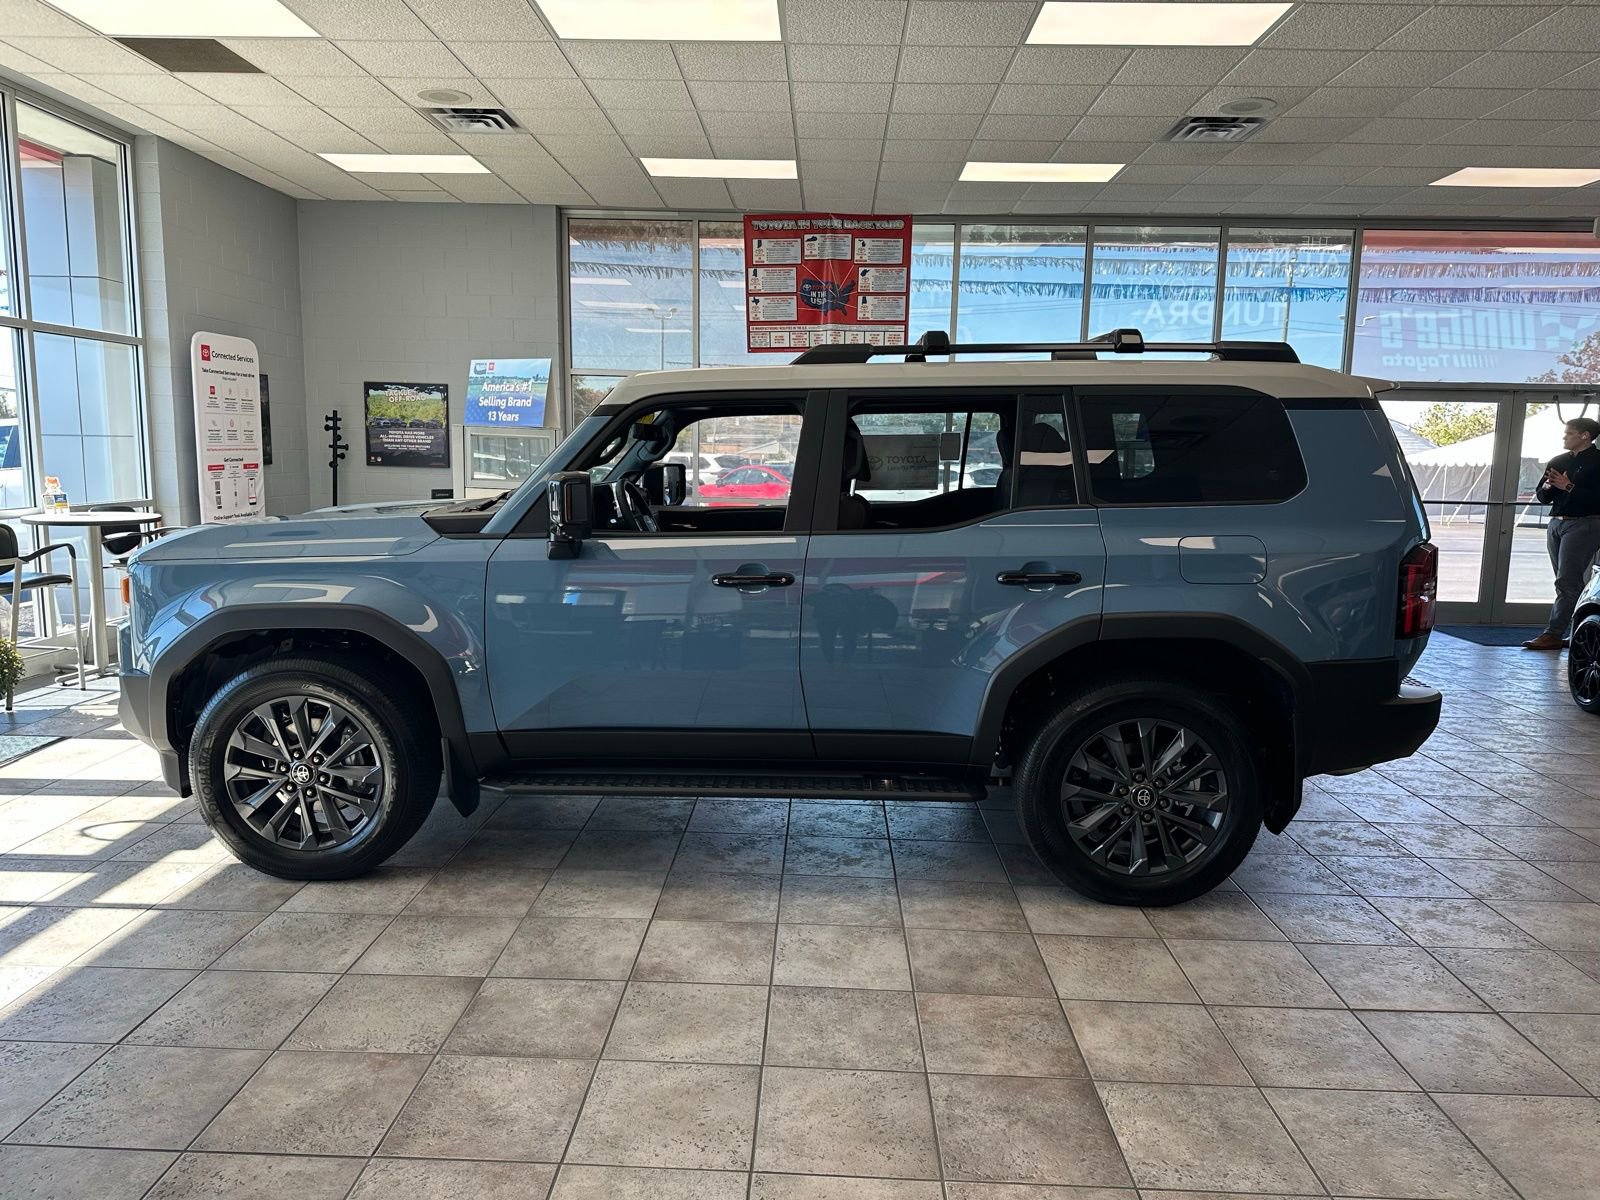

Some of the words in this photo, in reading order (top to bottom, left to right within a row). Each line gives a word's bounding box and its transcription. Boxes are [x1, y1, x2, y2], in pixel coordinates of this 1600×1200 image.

[752, 220, 796, 230] TOYOTA
[796, 220, 810, 230] IN
[812, 219, 842, 230] YOUR
[843, 219, 904, 230] BACKYARD
[212, 350, 236, 361] Connected
[237, 354, 254, 364] Services
[482, 381, 520, 391] America's
[521, 380, 532, 391] #1
[478, 396, 506, 409] Selling
[508, 396, 532, 406] Brand
[488, 411, 496, 420] 13
[498, 411, 519, 421] Years
[886, 455, 928, 464] TOYOTA
[198, 746, 221, 824] YOKOHAMA
